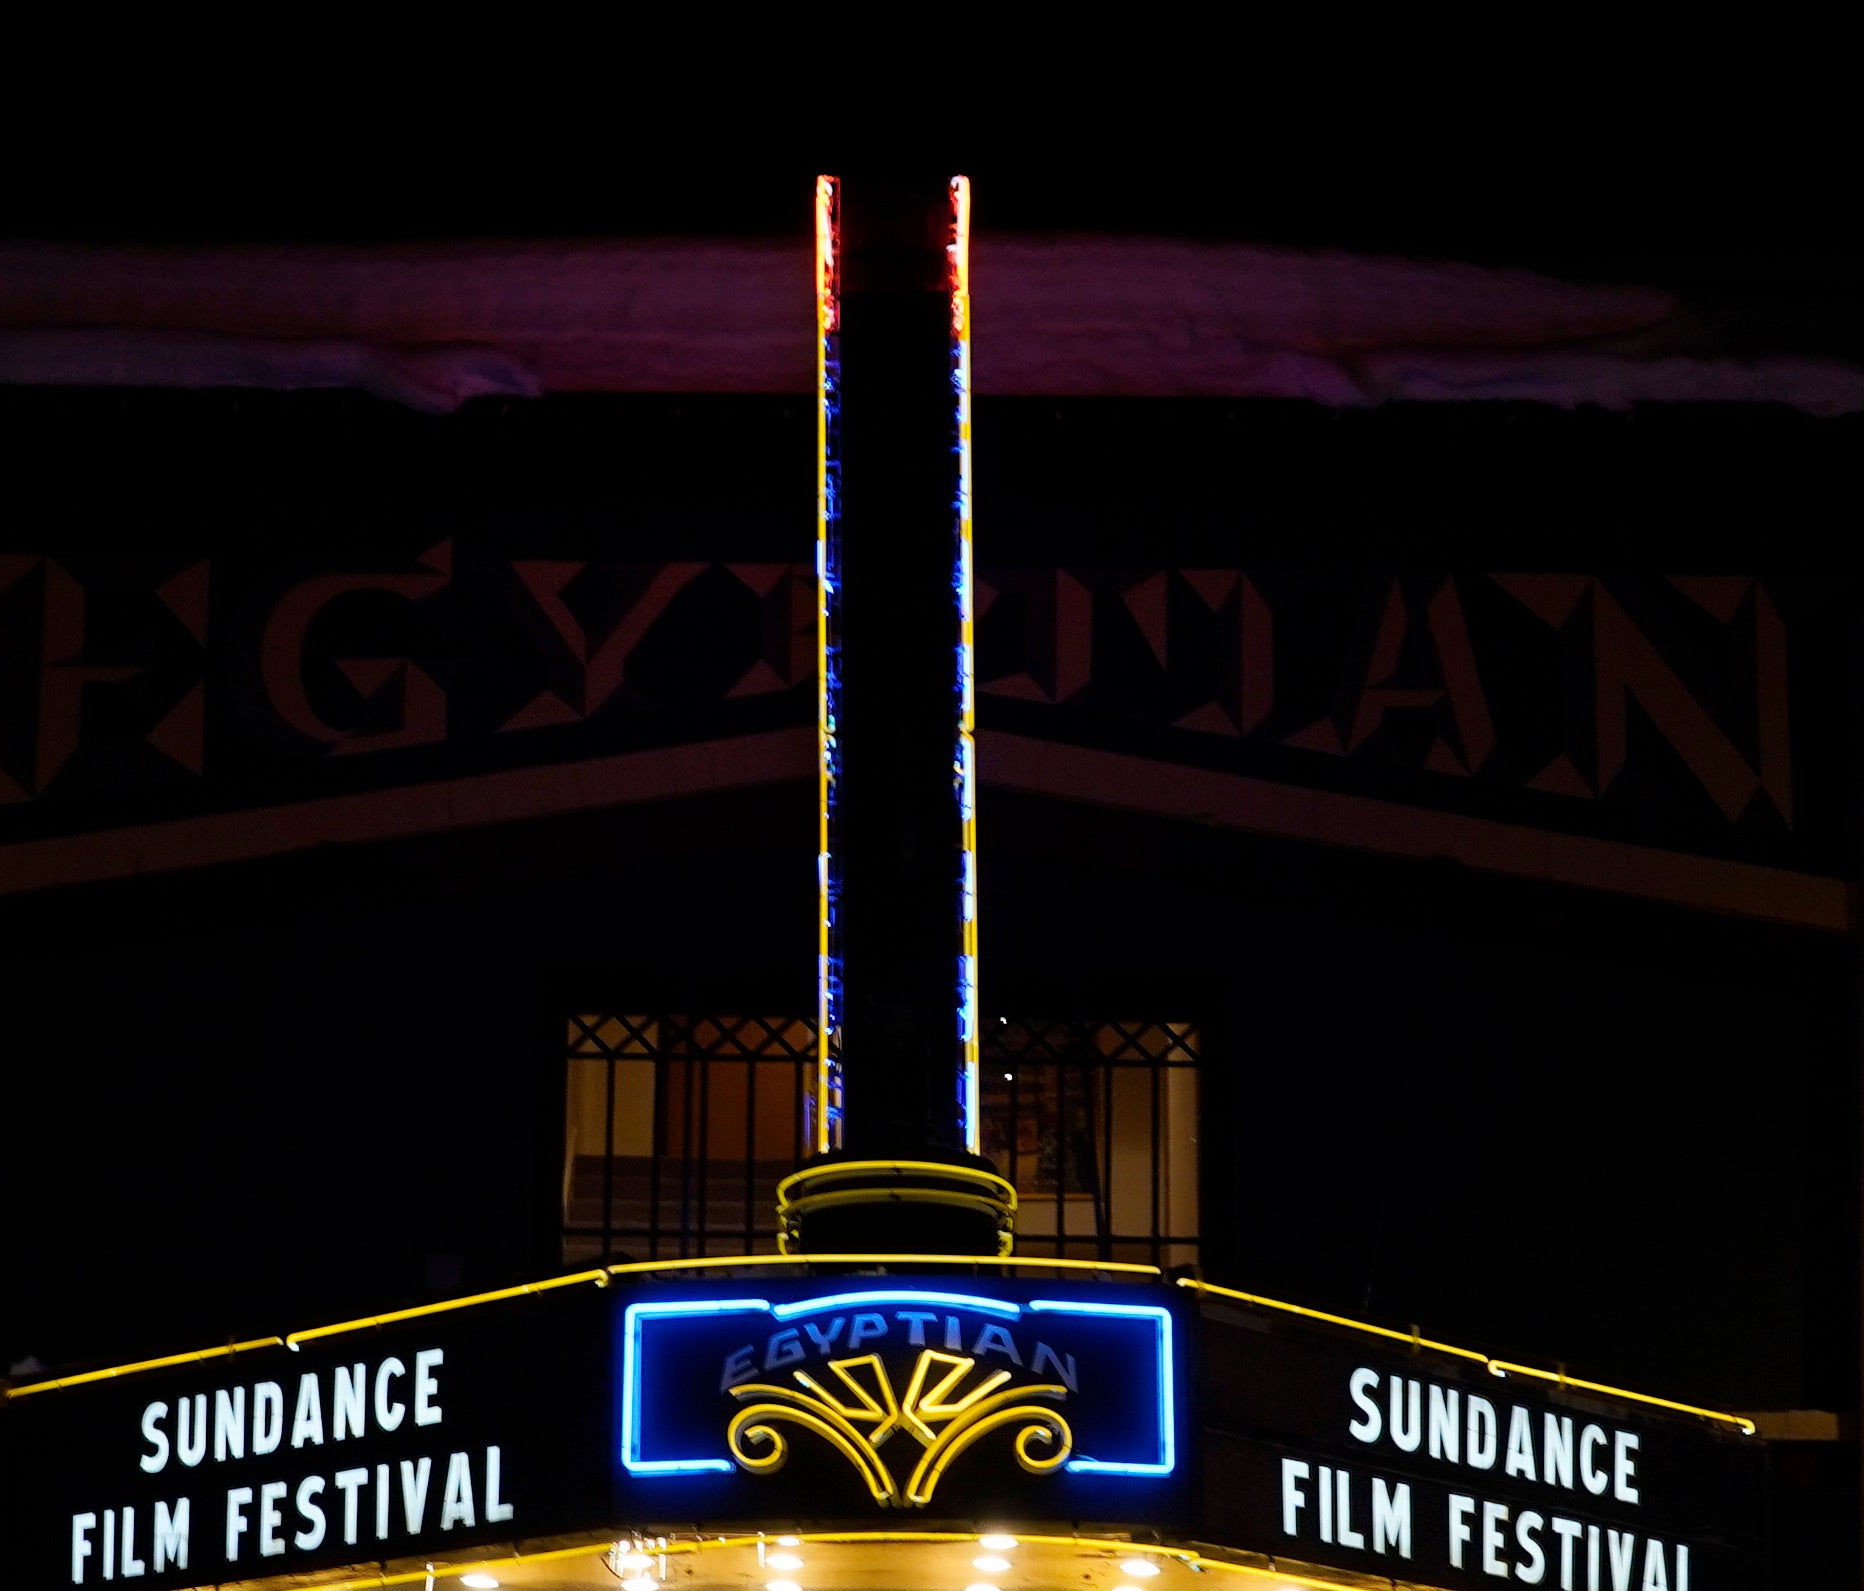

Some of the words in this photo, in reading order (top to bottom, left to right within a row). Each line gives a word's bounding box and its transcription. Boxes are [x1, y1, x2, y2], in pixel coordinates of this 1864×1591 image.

[139, 1347, 445, 1474] SUNDANCE
[719, 1310, 1079, 1394] EGYPTIAN
[1348, 1367, 1640, 1505] SUNDANCE
[71, 1497, 191, 1585] FILM
[225, 1445, 514, 1562] FESTIVAL
[1281, 1458, 1412, 1560] FILM
